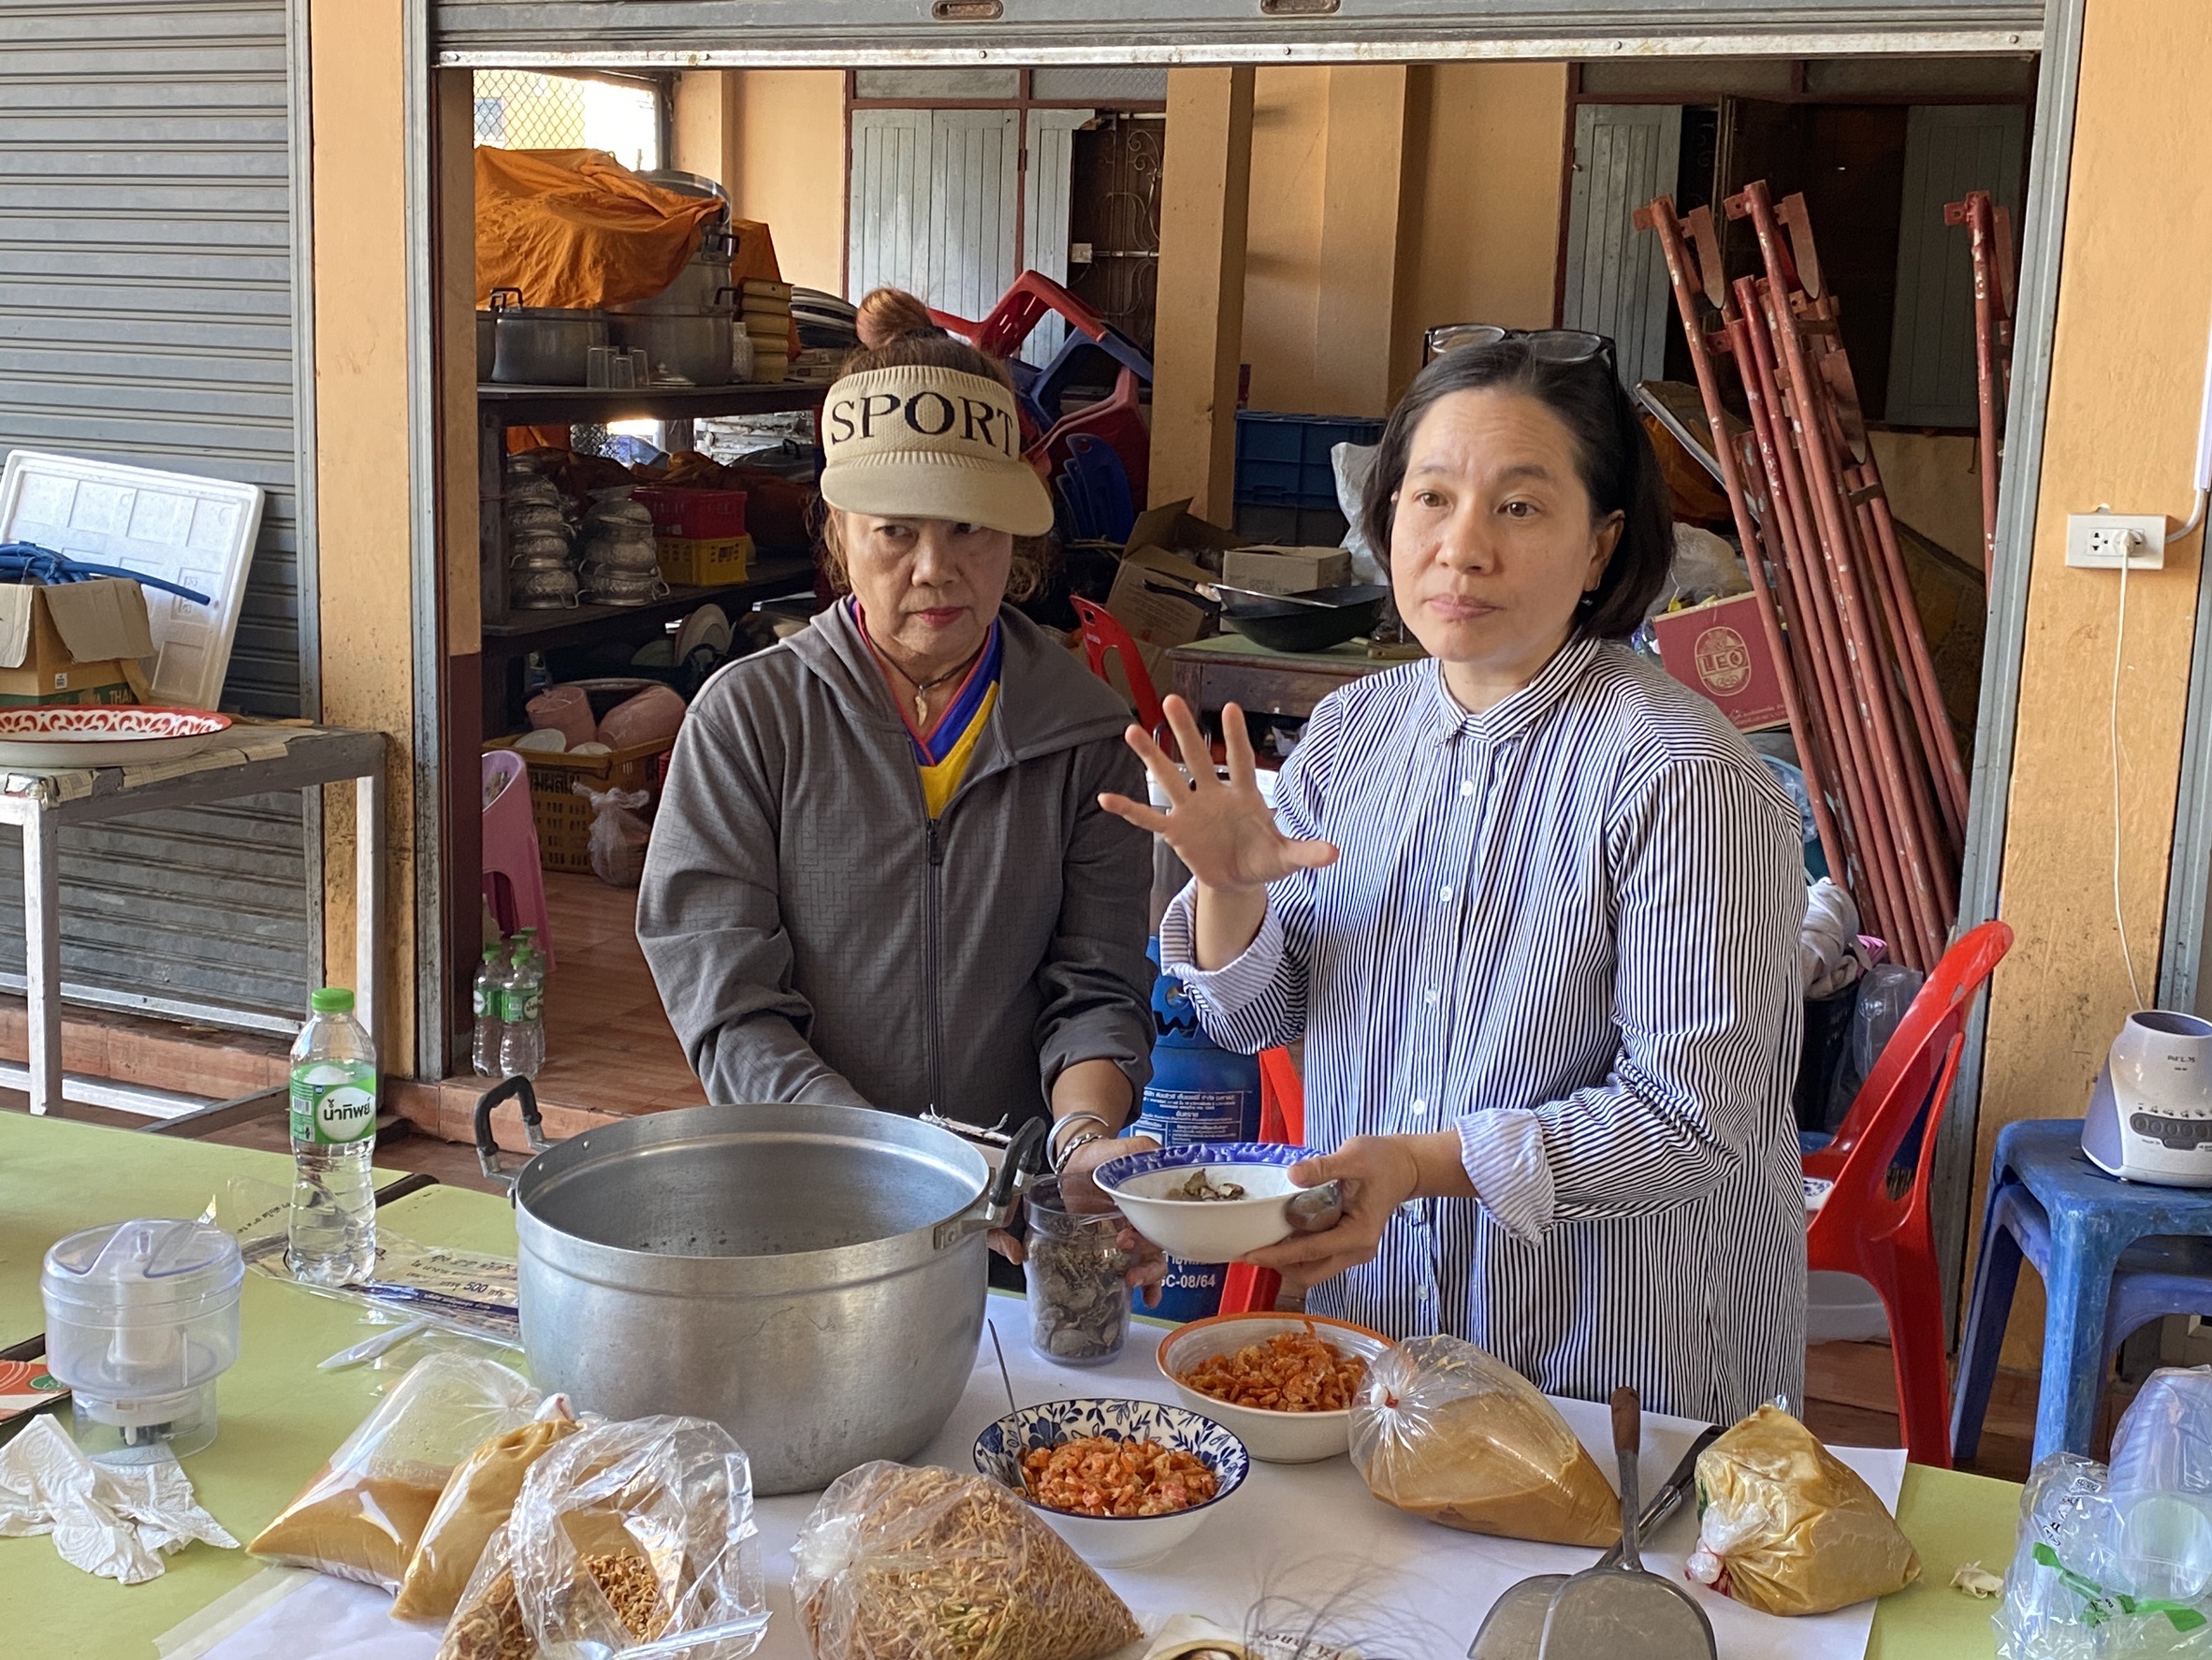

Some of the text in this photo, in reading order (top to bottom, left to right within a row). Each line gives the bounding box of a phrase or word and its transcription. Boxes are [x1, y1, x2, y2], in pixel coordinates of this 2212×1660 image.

[831, 391, 1013, 458] SPORT
[1698, 648, 1744, 677] LEO
[323, 1096, 371, 1121] น้ำทิพย์
[463, 1281, 488, 1293] 500
